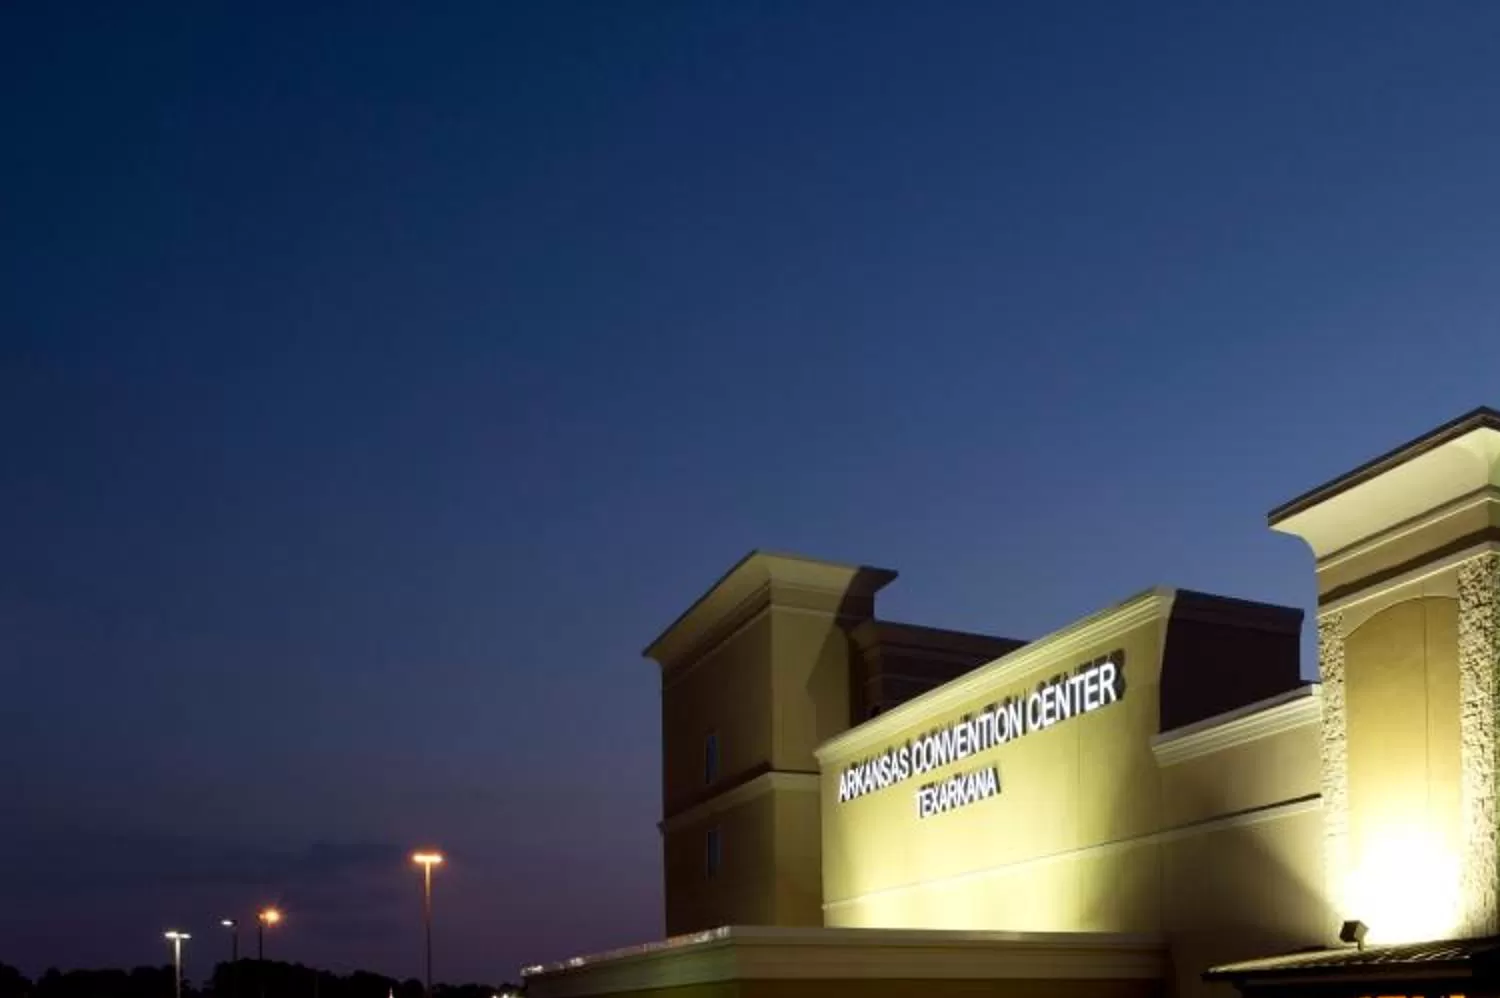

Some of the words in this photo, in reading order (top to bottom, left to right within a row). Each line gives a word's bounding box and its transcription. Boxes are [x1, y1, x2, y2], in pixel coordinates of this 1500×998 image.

[838, 747, 910, 801] ARKANSAS
[911, 703, 1022, 773] CONVENTION
[1026, 661, 1117, 730] CENTER
[917, 767, 997, 817] TEXARKANA
